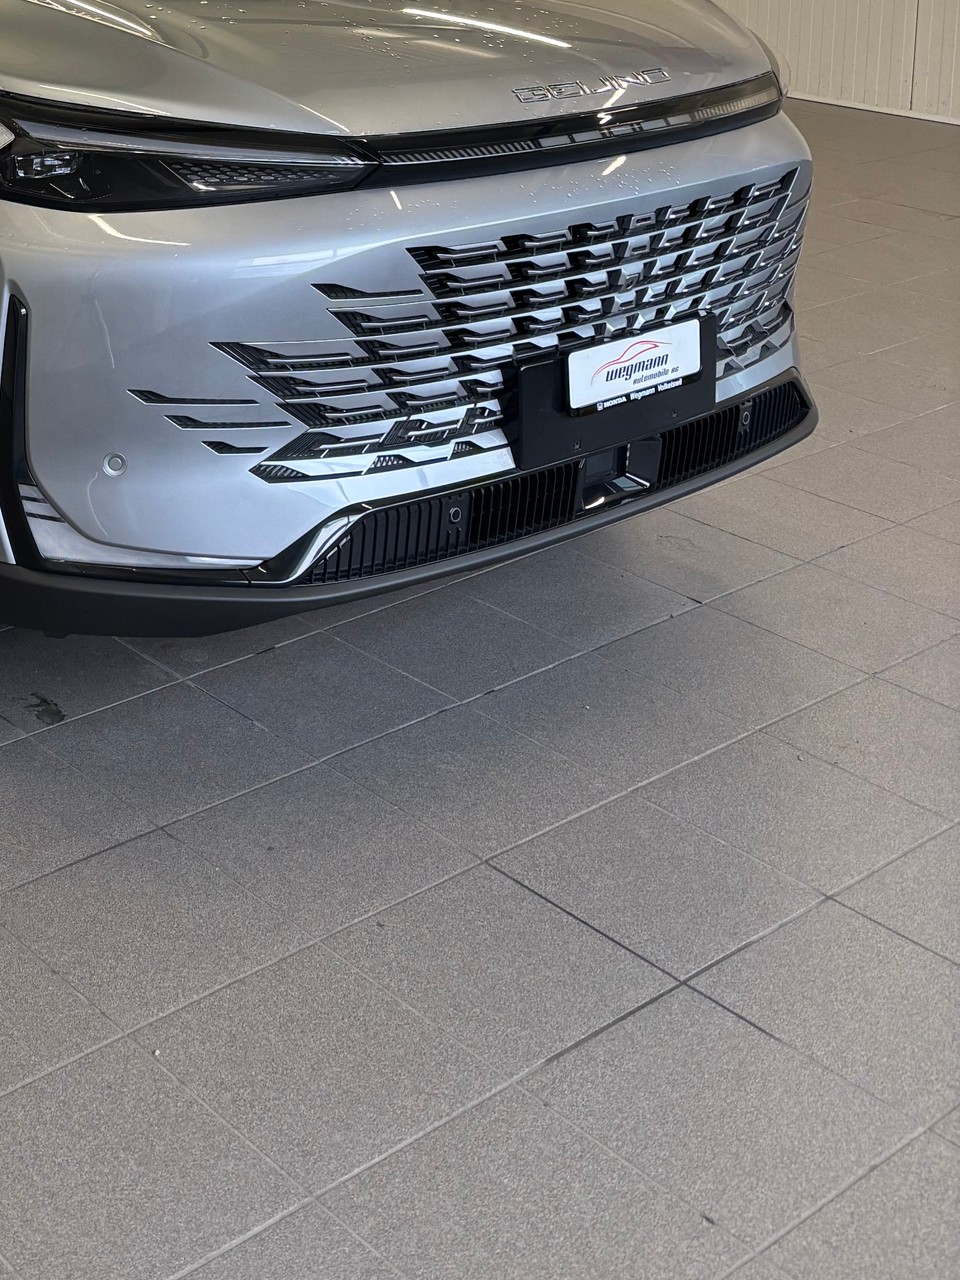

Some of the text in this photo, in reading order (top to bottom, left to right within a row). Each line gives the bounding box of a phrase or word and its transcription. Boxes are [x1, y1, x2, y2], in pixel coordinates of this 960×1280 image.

[605, 353, 669, 381] wegmann
[604, 396, 627, 408] HONDA
[630, 387, 655, 401] Wegmann
